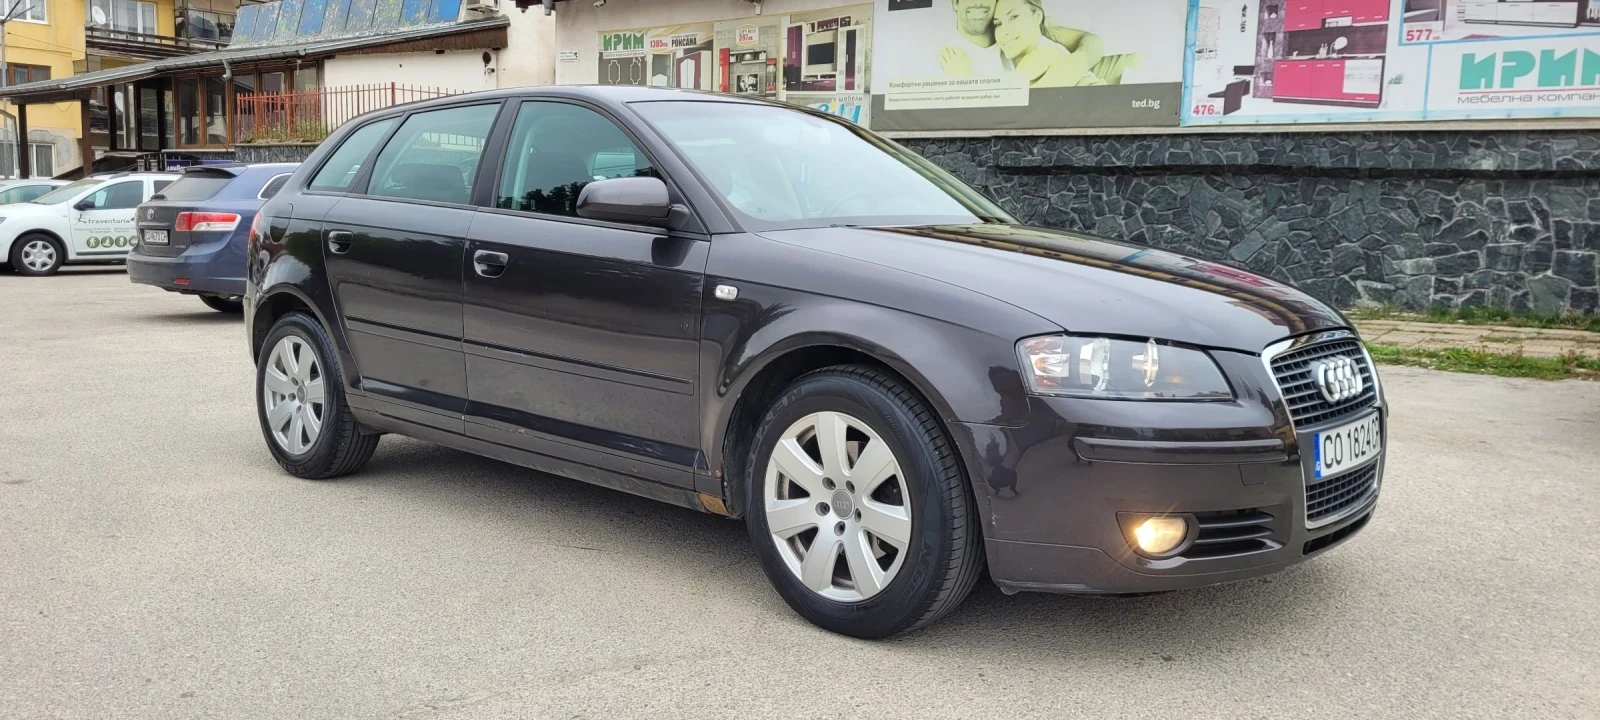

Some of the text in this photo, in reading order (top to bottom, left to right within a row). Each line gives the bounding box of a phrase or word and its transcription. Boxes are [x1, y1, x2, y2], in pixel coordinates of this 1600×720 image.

[603, 31, 645, 51] ИРИМ
[671, 37, 697, 48] РОКСАНА
[838, 94, 863, 102] мебели
[1457, 94, 1532, 104] мебелна
[1132, 98, 1160, 110] ted.bg
[1324, 432, 1343, 468] CO
